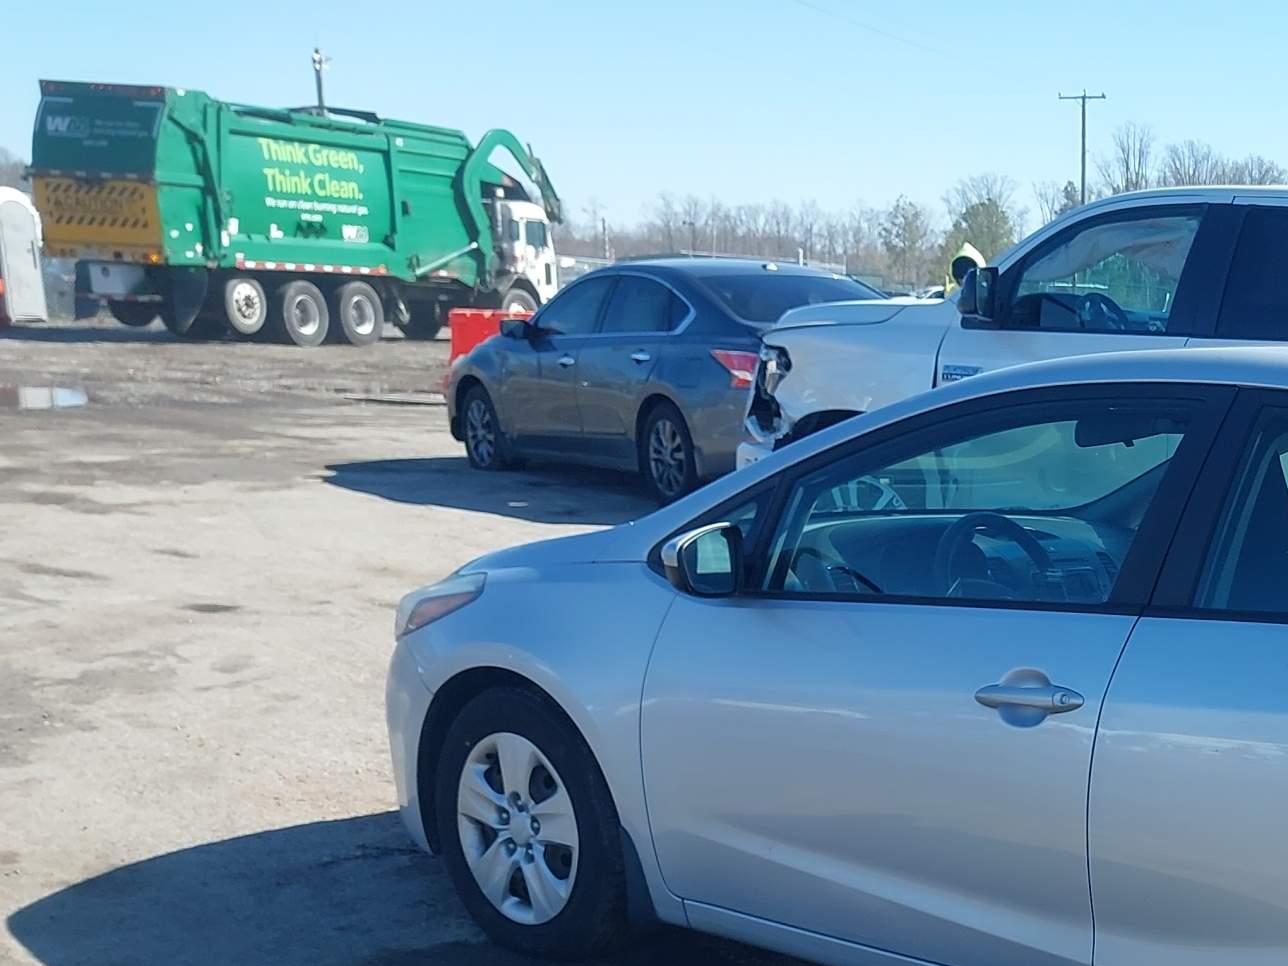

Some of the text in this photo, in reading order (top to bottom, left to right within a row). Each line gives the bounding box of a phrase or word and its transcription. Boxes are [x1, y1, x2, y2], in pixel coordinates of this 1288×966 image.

[258, 137, 364, 174] Think Green,
[263, 167, 364, 200] Think Clean.
